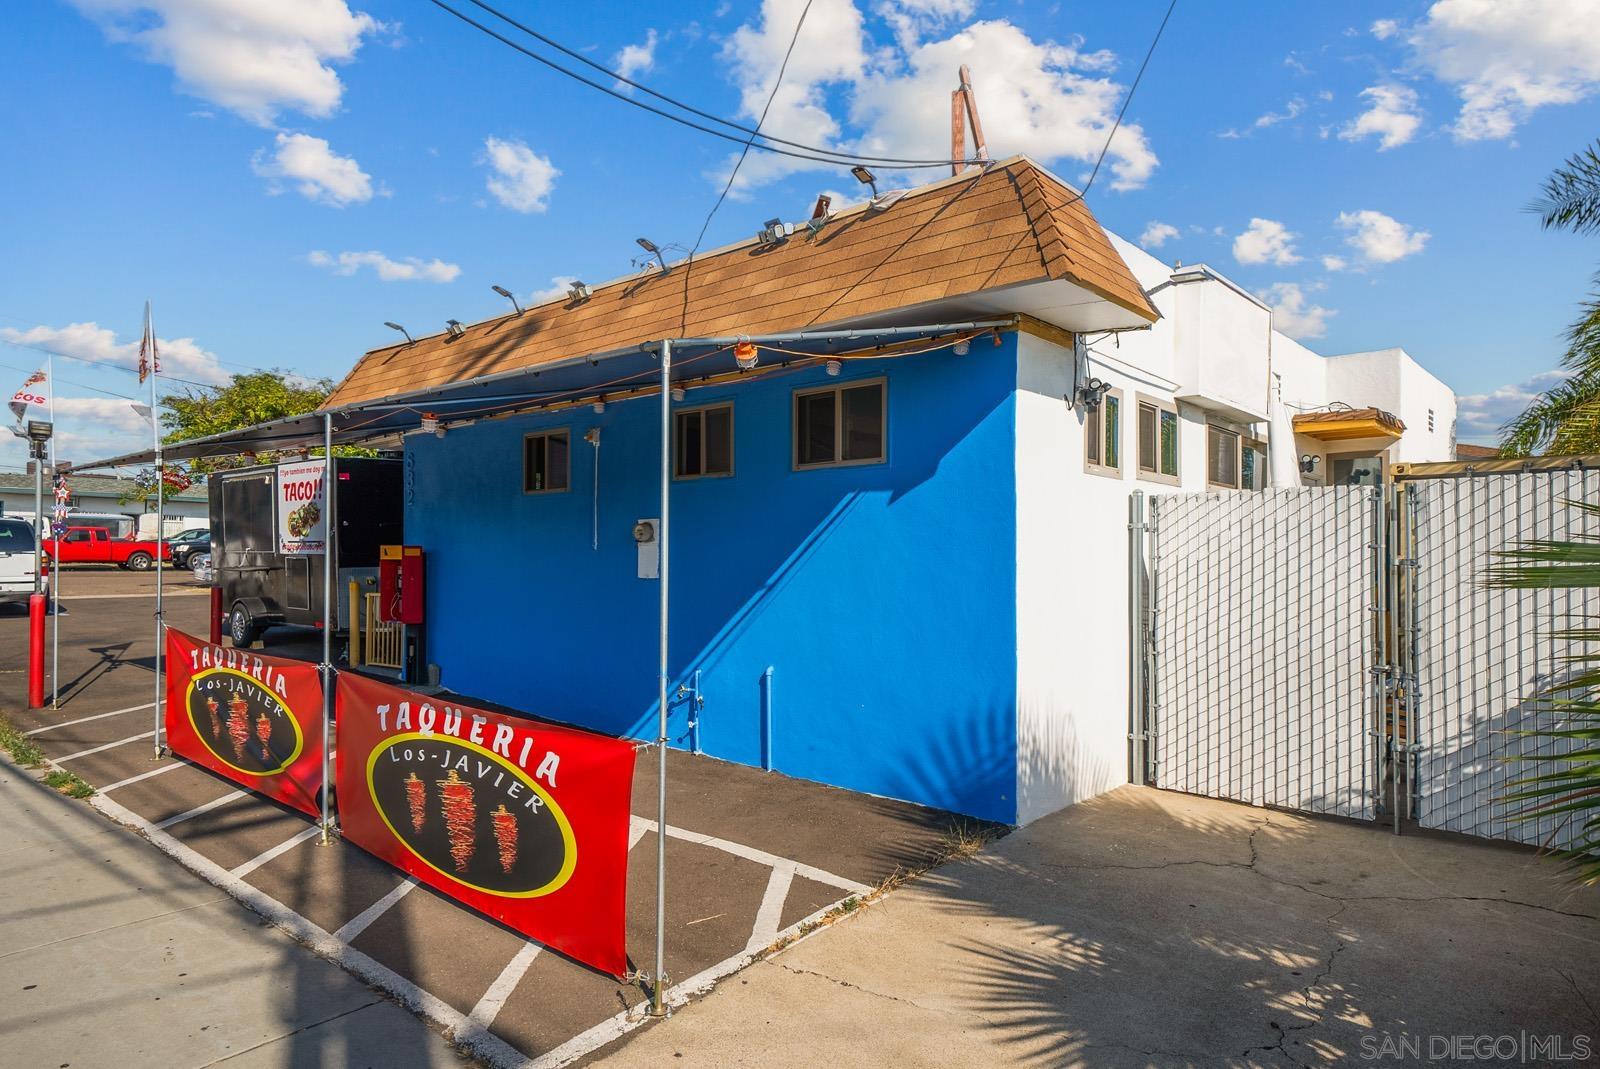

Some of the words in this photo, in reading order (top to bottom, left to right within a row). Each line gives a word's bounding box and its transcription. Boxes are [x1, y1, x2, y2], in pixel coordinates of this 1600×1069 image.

[283, 478, 323, 502] TACO!!
[191, 646, 288, 698] TAQUERIA
[376, 701, 561, 788] TAQUERIA
